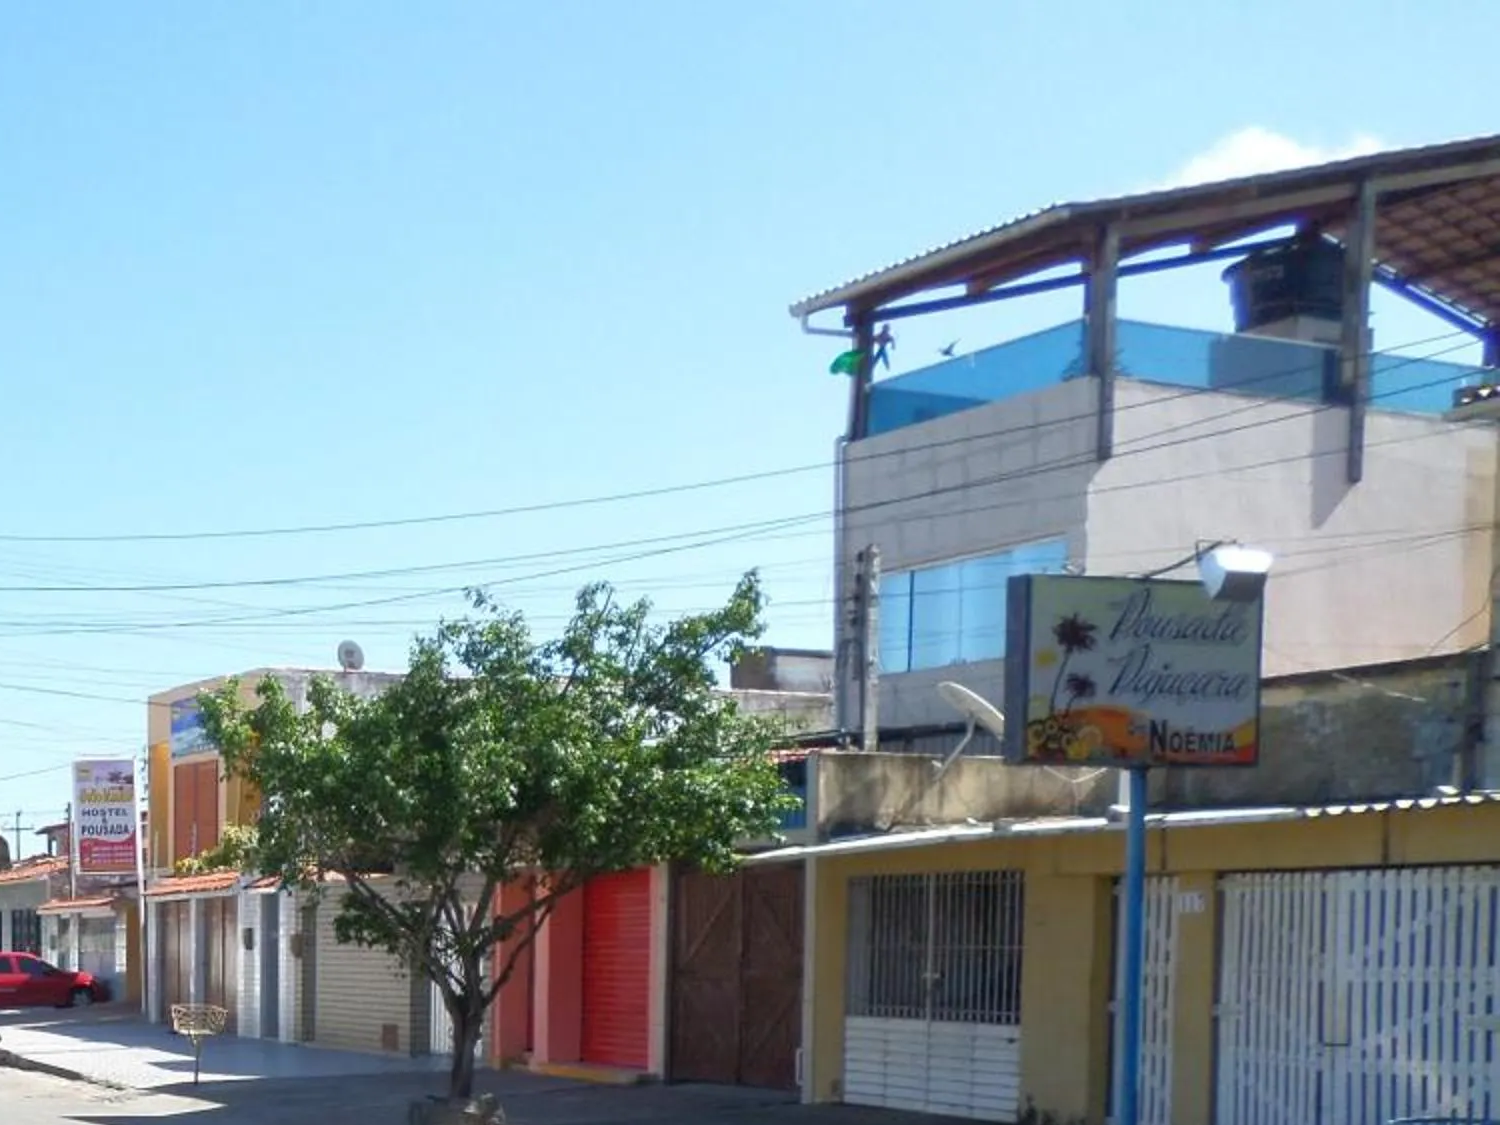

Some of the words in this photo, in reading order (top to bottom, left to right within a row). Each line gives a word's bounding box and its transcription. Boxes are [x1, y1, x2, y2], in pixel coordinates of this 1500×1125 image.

[1107, 587, 1246, 642] Pousada
[81, 807, 129, 817] HOSTEL
[81, 823, 130, 835] POUSADA
